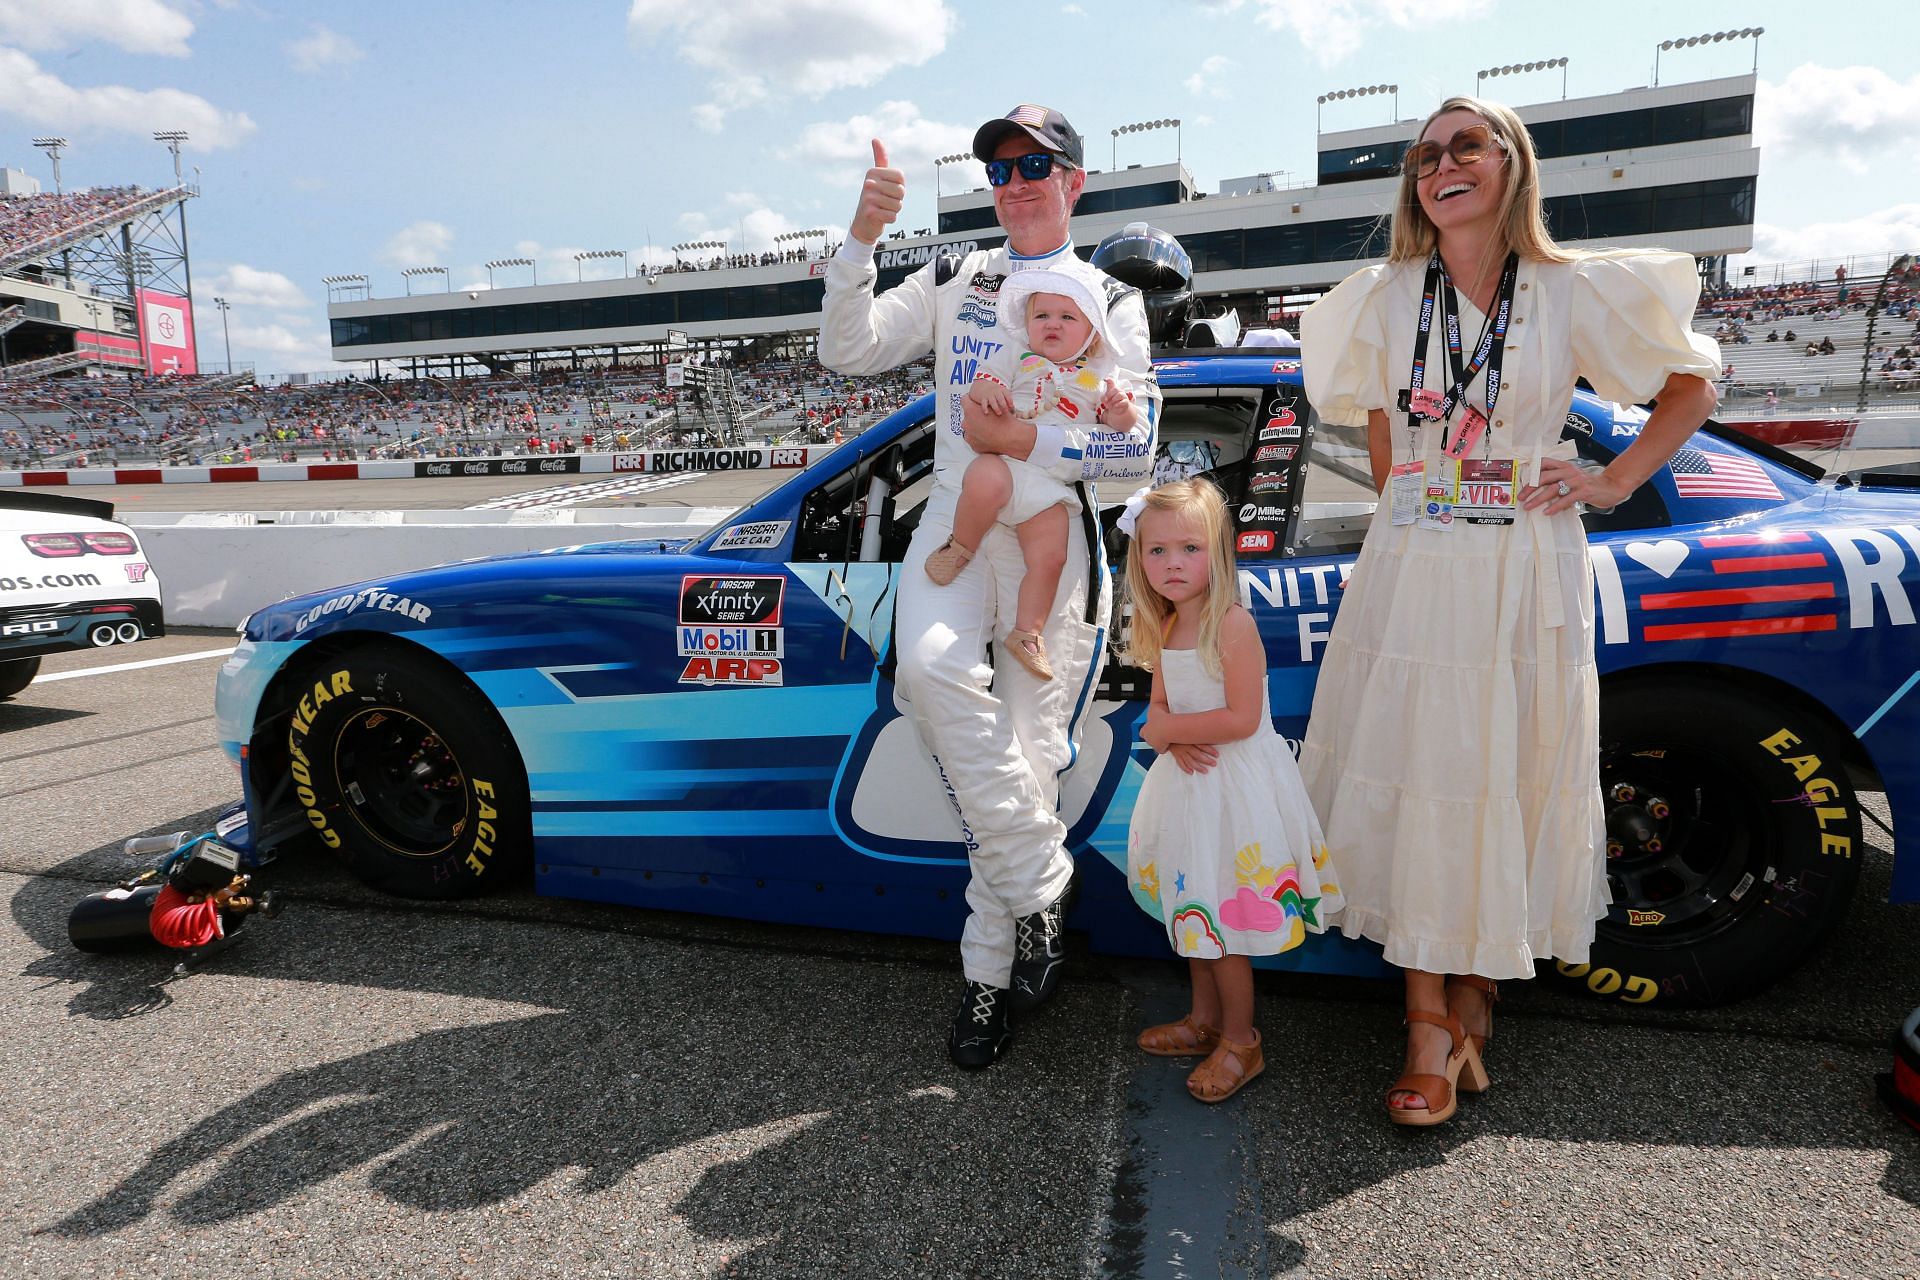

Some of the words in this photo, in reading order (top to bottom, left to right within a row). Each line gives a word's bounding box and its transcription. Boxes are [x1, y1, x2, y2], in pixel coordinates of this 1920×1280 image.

[1419, 300, 1432, 332] NASCAR
[1496, 299, 1510, 330] NASCAR
[1447, 314, 1459, 344] NASCAR
[1487, 368, 1500, 406] NASCAR
[615, 454, 642, 469] RR
[652, 450, 763, 472] RICHMOND
[772, 448, 803, 465] RR
[1257, 506, 1286, 516] Miller
[720, 537, 747, 547] RACE
[748, 536, 772, 545] CAR
[737, 524, 779, 536] NASCAR
[1241, 535, 1268, 549] SEM
[124, 563, 149, 583] 17
[720, 580, 756, 590] NASCAR
[295, 588, 432, 633] GOODYEAR
[696, 590, 766, 616] xfinity
[717, 611, 746, 621] SERIES
[682, 628, 748, 651] Mobil
[682, 658, 780, 681] ARP
[289, 670, 353, 849] GOODYEAR
[1758, 728, 1851, 859] EAGLE
[465, 778, 498, 876] EAGLE
